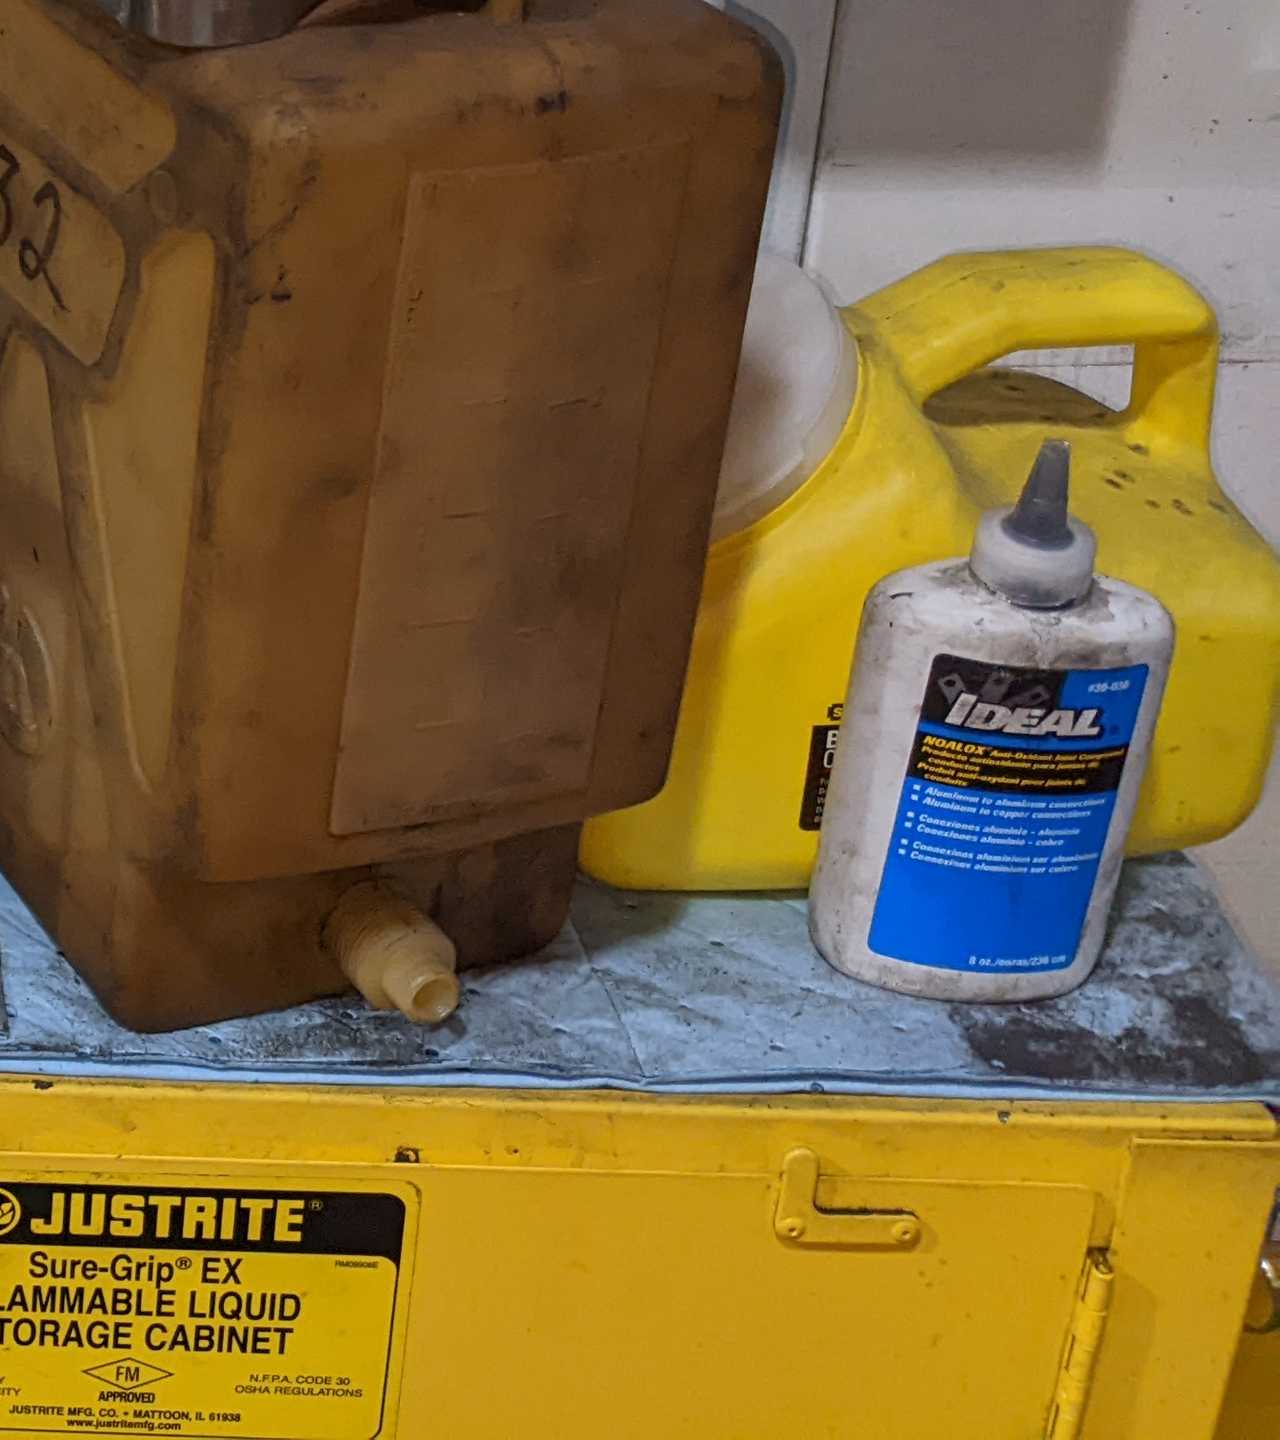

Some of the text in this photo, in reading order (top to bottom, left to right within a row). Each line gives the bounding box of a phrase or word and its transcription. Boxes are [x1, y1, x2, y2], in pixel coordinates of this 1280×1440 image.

[943, 691, 1101, 738] IDEAL
[923, 735, 984, 757] NOALOX
[925, 785, 980, 805] Aluminum
[981, 795, 993, 806] to
[922, 795, 978, 814] Aluminum
[979, 805, 991, 815] to
[992, 808, 1030, 820] copper
[200, 1257, 243, 1285] EX
[187, 1289, 302, 1323] LIQUID
[143, 1323, 295, 1356] CABINET
[114, 1366, 141, 1383] FM
[295, 1376, 332, 1386] CODE
[335, 1376, 351, 1386] 30
[97, 1391, 156, 1404] APPROVED
[234, 1385, 363, 1398] OSHA REGULATIONS
[8, 1404, 241, 1422] JUSTRITE MFG. CO. MATTOON, IL 61938
[65, 1418, 182, 1432] www.justritemfg.com
